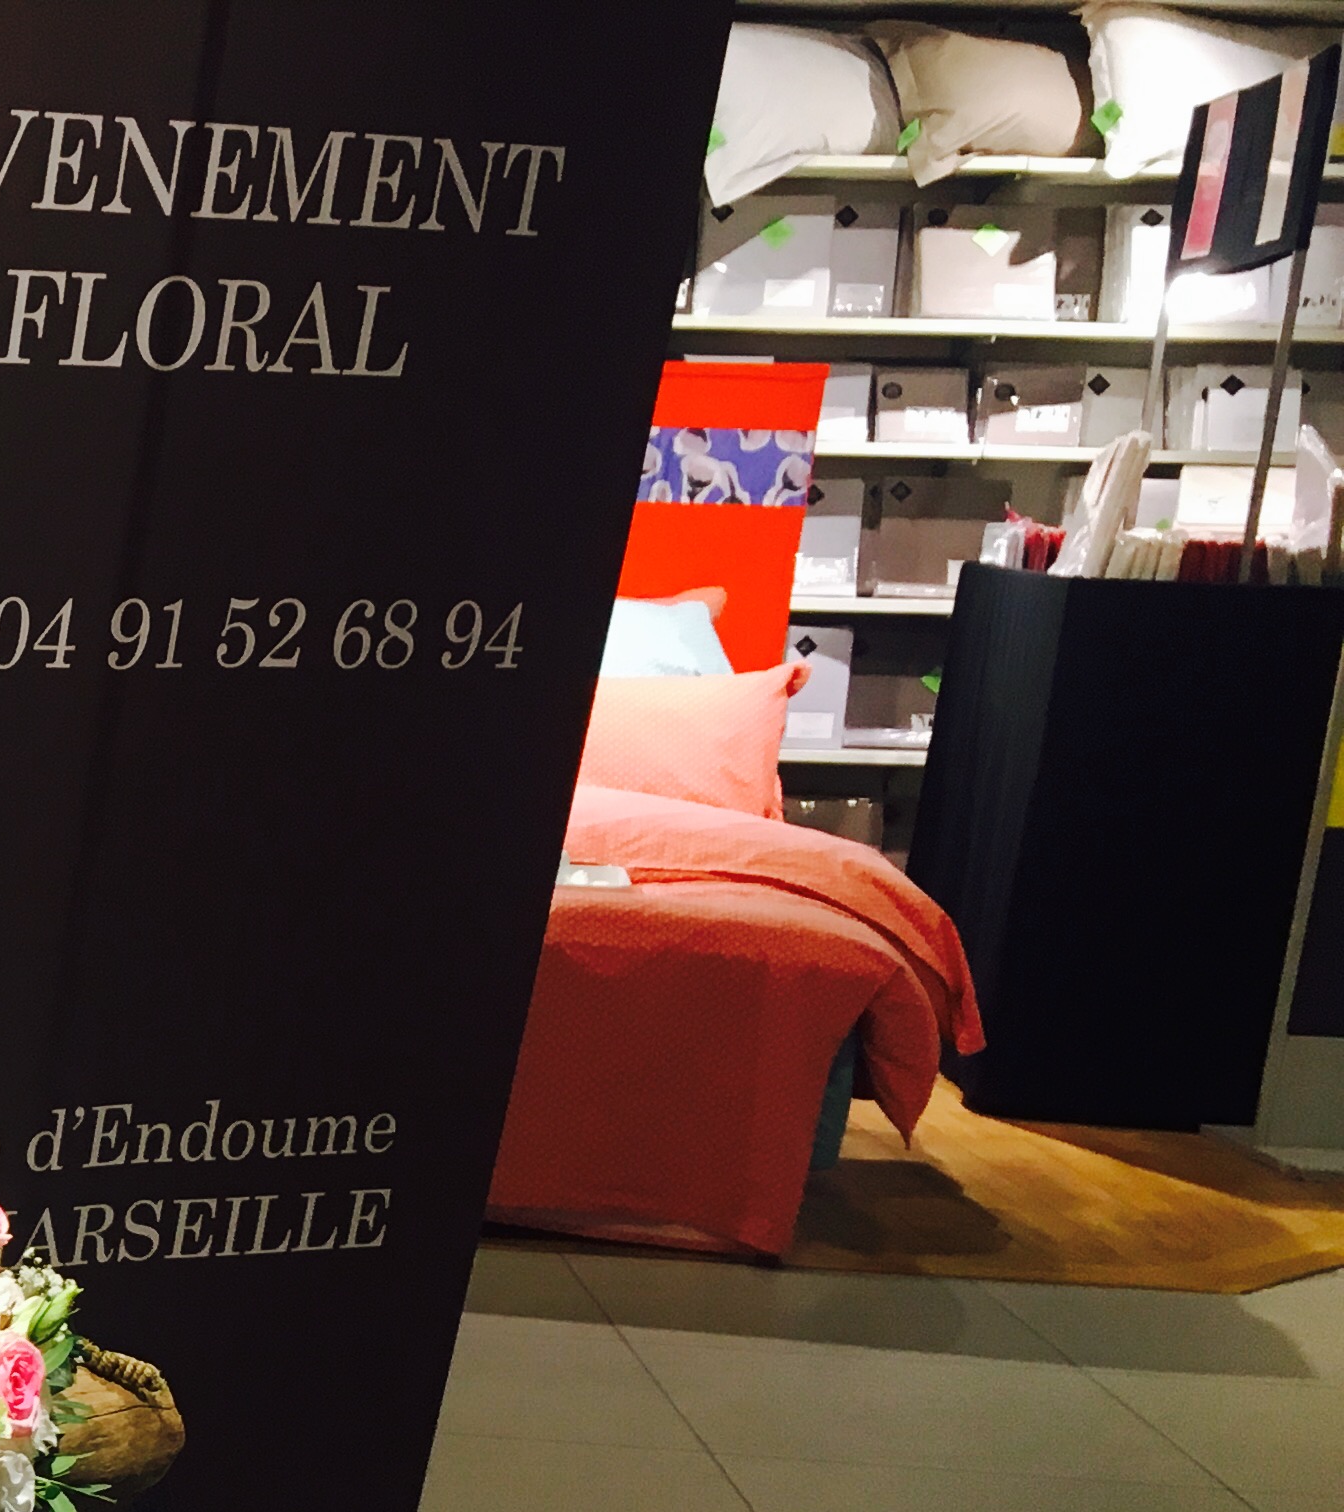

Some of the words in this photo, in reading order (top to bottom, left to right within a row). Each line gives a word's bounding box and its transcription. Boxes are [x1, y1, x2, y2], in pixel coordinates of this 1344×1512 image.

[107, 597, 183, 670] 91
[216, 597, 307, 669] 52
[333, 599, 418, 669] 68
[441, 600, 523, 669] 94
[26, 1099, 397, 1172] d'Endoume
[5, 1188, 392, 1271] ARSEILLE
